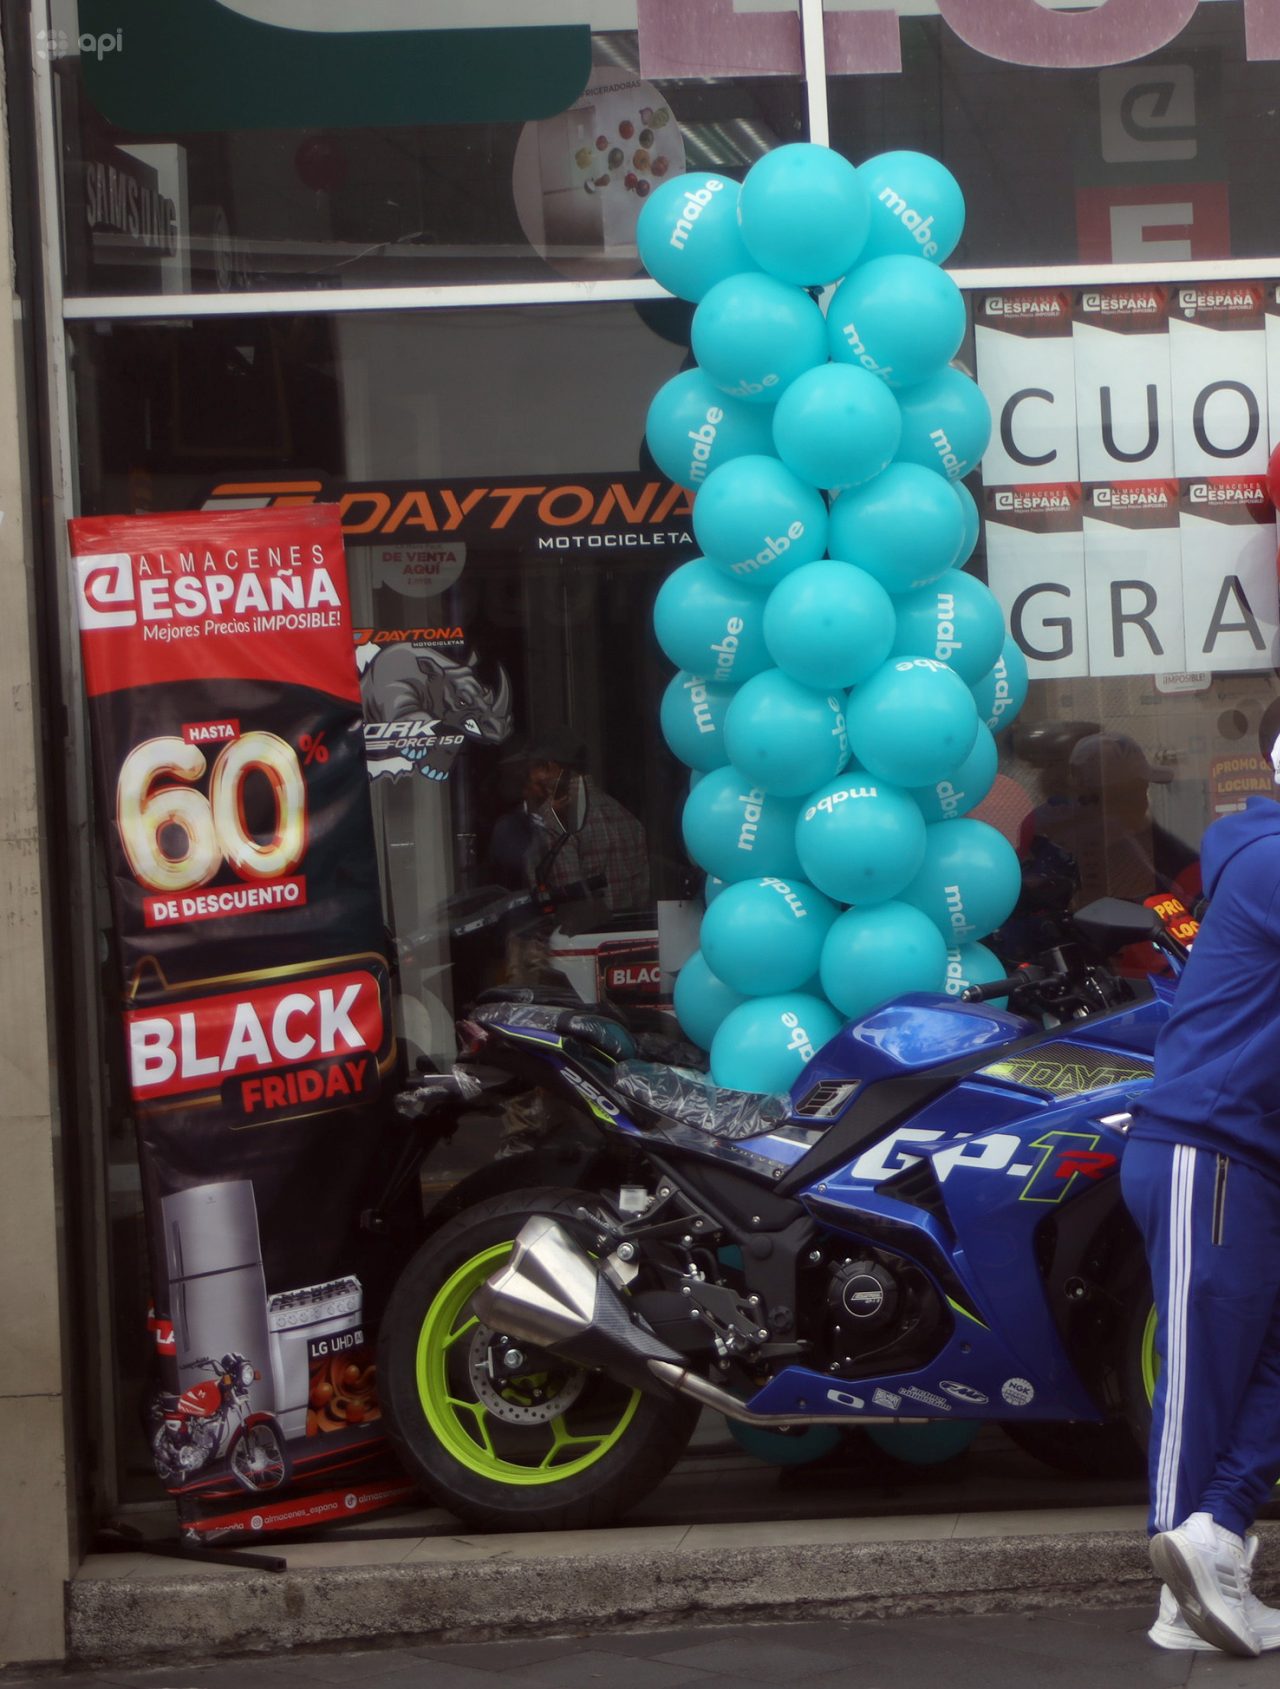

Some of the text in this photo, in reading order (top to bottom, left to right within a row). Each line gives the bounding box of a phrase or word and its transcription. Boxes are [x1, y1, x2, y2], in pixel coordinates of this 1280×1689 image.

[86, 160, 179, 258] SAMSUNG
[669, 179, 724, 250] mabe
[878, 187, 938, 257] mabe
[1004, 301, 1060, 313] ESPAÑA
[1101, 298, 1158, 310] ESPAÑA
[1197, 294, 1254, 307] ESPAÑA
[689, 406, 724, 482] mabe
[929, 429, 967, 482] mab
[341, 482, 698, 534] DAYTONA
[1014, 495, 1071, 509] ESPAÑA
[1112, 492, 1168, 505] ESPAÑA
[1208, 488, 1264, 500] ESPAÑA
[382, 550, 457, 562] DE VENTA
[538, 531, 693, 550] MOTOCICLETA
[731, 520, 804, 575] mabe
[139, 544, 324, 576] ALMACENES
[402, 562, 440, 575] AQUÍ
[140, 568, 341, 620] ESPAÑA
[143, 611, 341, 642] Mejores Precios ¡IMPOSIBLE!
[374, 626, 465, 643] DAYTONA
[934, 593, 962, 661] mab
[711, 616, 743, 681] mabe
[987, 655, 1014, 730] mabe
[190, 724, 235, 741] HASTA
[363, 719, 441, 738] ORK
[387, 734, 464, 749] FORCE 150
[736, 787, 767, 851] mab
[804, 787, 878, 821] mabe
[153, 883, 300, 921] DE DESCUENTO
[760, 876, 808, 918] mab
[612, 967, 661, 985] BLAC
[130, 984, 366, 1087] BLACK
[781, 1011, 816, 1063] abe
[241, 1059, 368, 1114] FRIDAY
[311, 1334, 354, 1357] LG UHD
[1008, 1381, 1031, 1394] NGK
